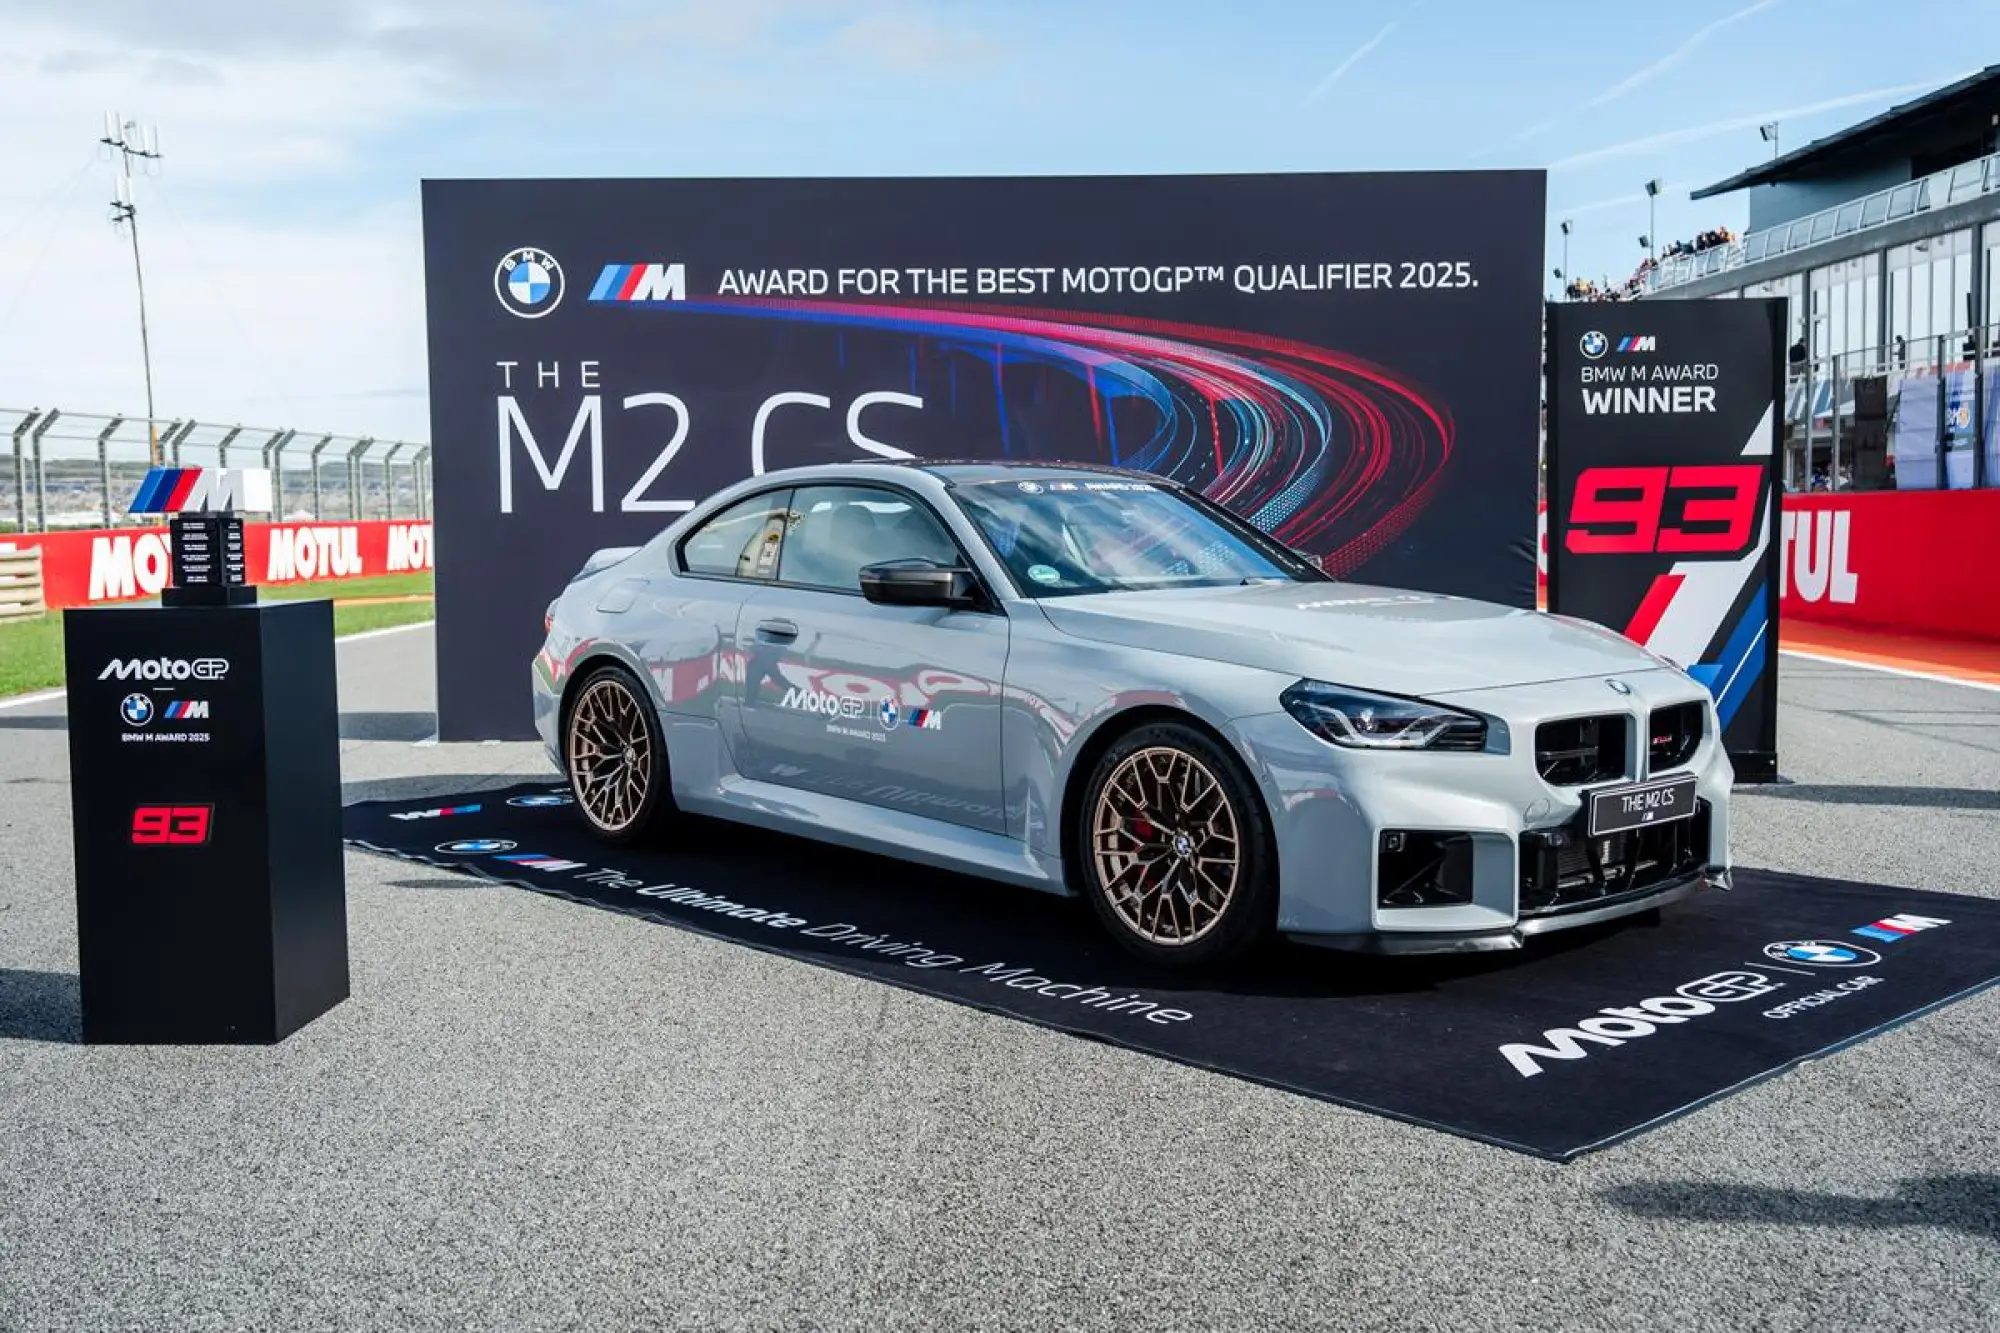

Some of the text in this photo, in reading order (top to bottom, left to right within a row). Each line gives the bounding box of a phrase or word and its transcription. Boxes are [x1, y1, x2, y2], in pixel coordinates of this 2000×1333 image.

[718, 262, 1479, 294] AWARD FOR THE BEST MOTOGP™ QUALIFIER 2025.
[496, 361, 601, 388] THE
[1581, 364, 1719, 382] BMW M AWARD
[1582, 386, 1717, 414] WINNER
[498, 392, 695, 513] M2
[1565, 465, 1763, 554] 93
[267, 526, 362, 581] MOTUL
[98, 657, 230, 680] MotoGP
[780, 688, 865, 719] MotoGP
[1621, 787, 1675, 813] THE M2 CS
[132, 807, 209, 844] 93
[573, 867, 1193, 1024] The Ultimate Driving Machine
[1499, 970, 1786, 1078] MotoGP
